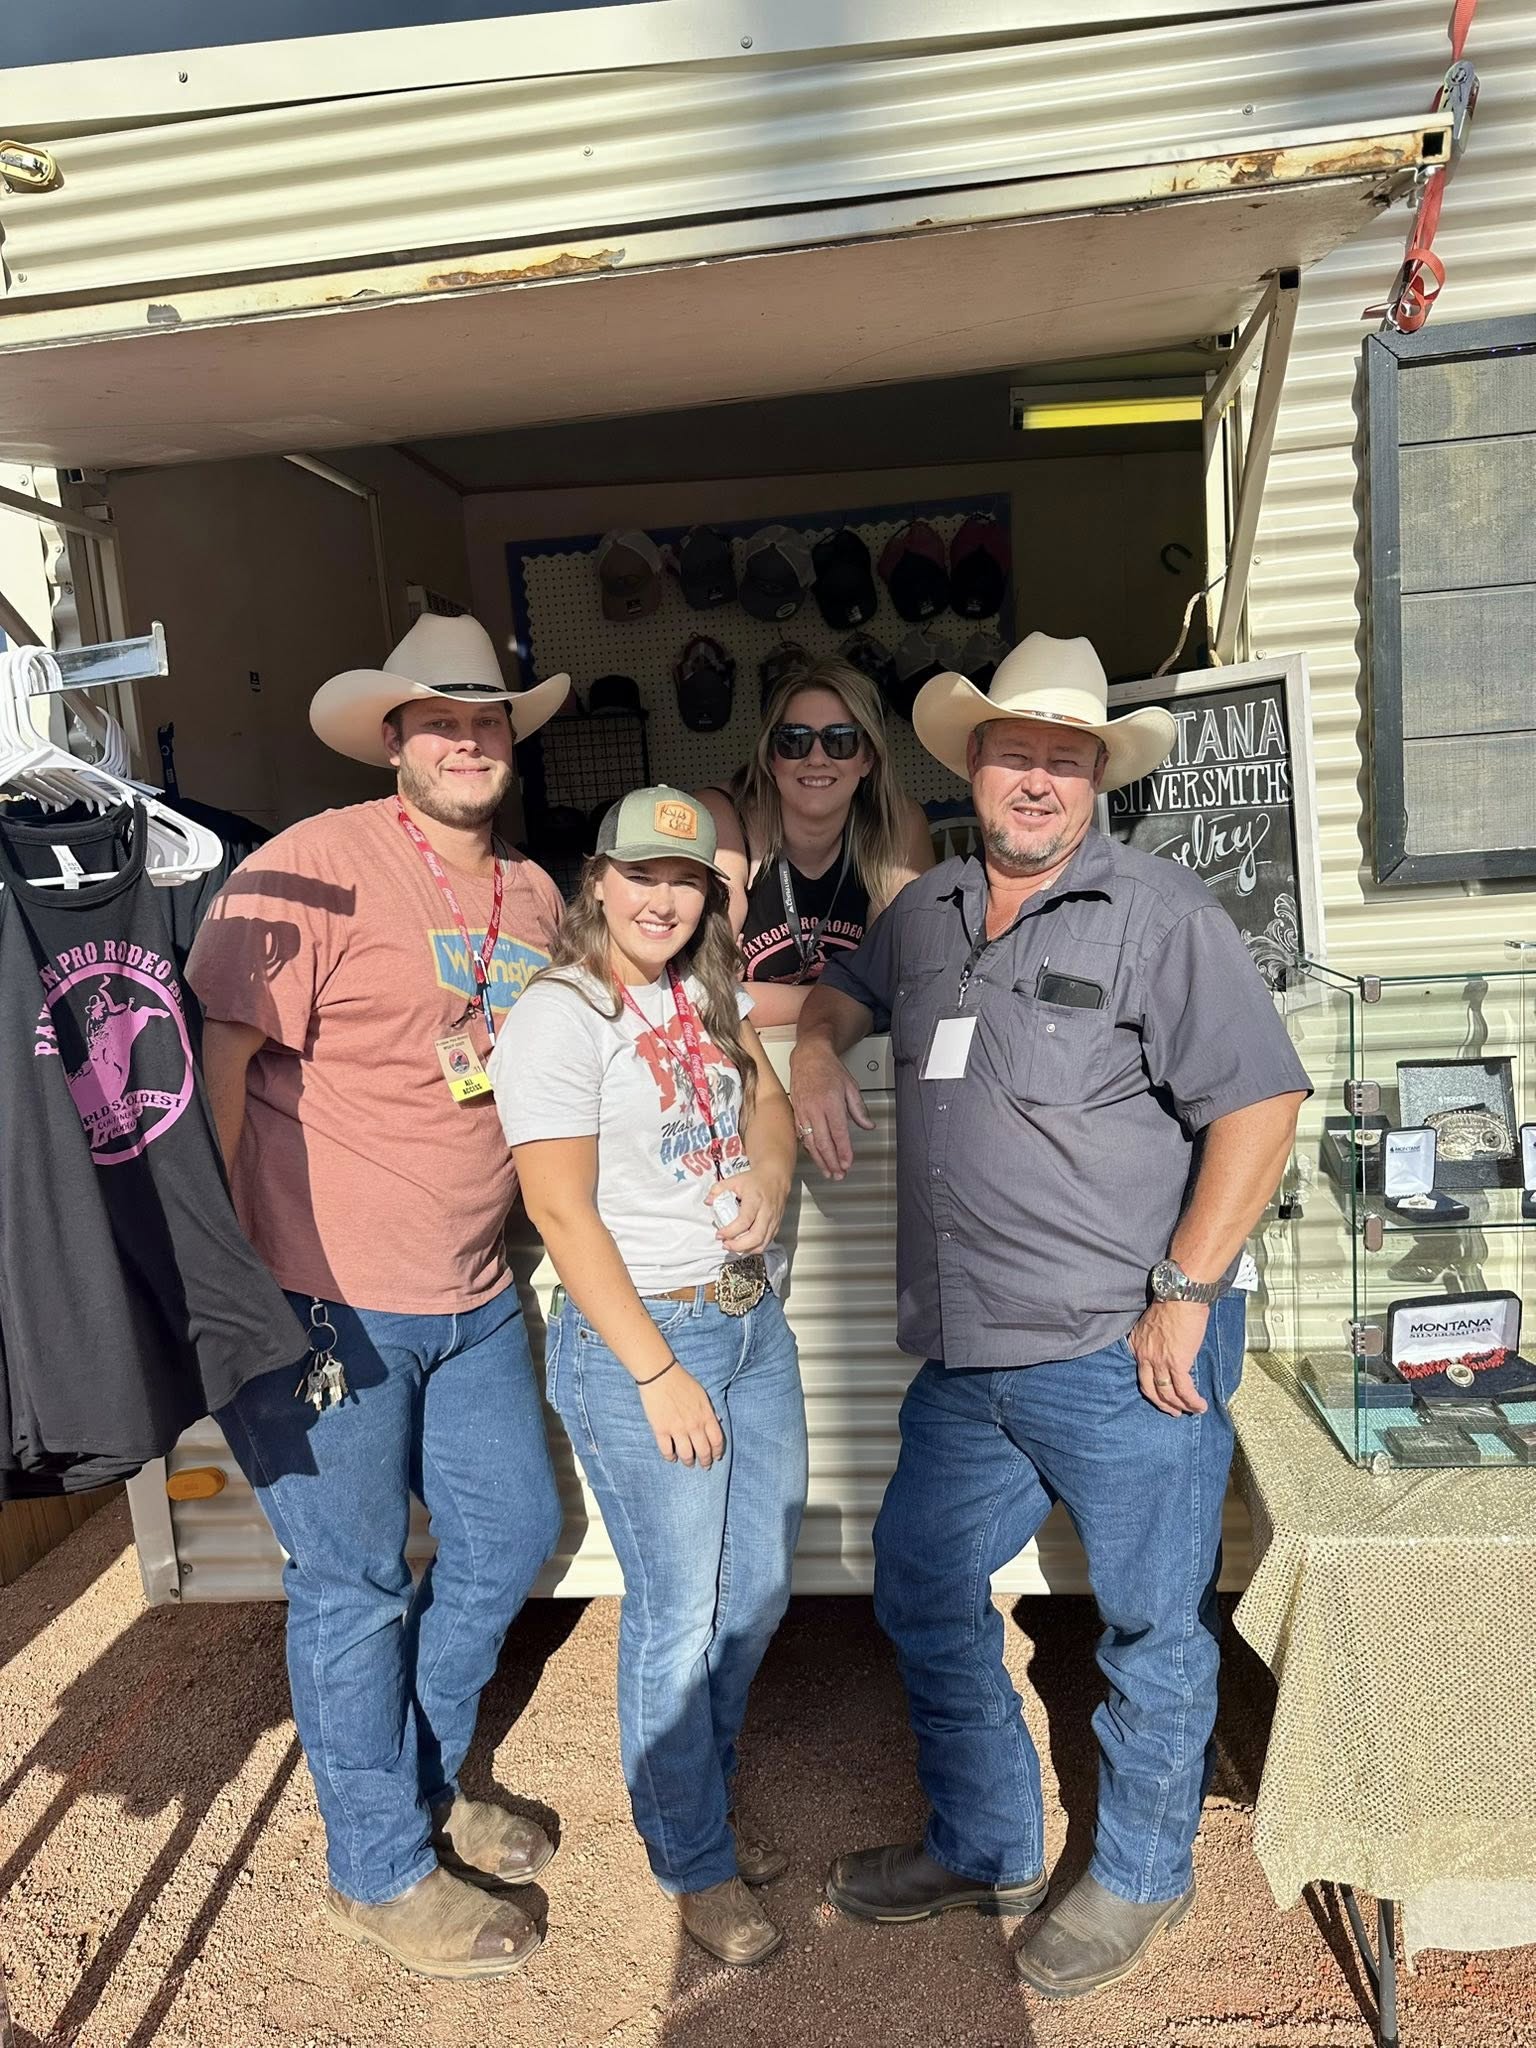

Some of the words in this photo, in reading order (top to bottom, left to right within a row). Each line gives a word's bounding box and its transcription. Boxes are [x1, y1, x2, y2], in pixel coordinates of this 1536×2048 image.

[1158, 698, 1288, 770] TANA
[1113, 760, 1294, 814] SILVERSMITHS
[56, 941, 99, 975] PRO
[103, 939, 172, 981] RODEO
[742, 922, 791, 960] PAYSON
[800, 916, 819, 931] RO
